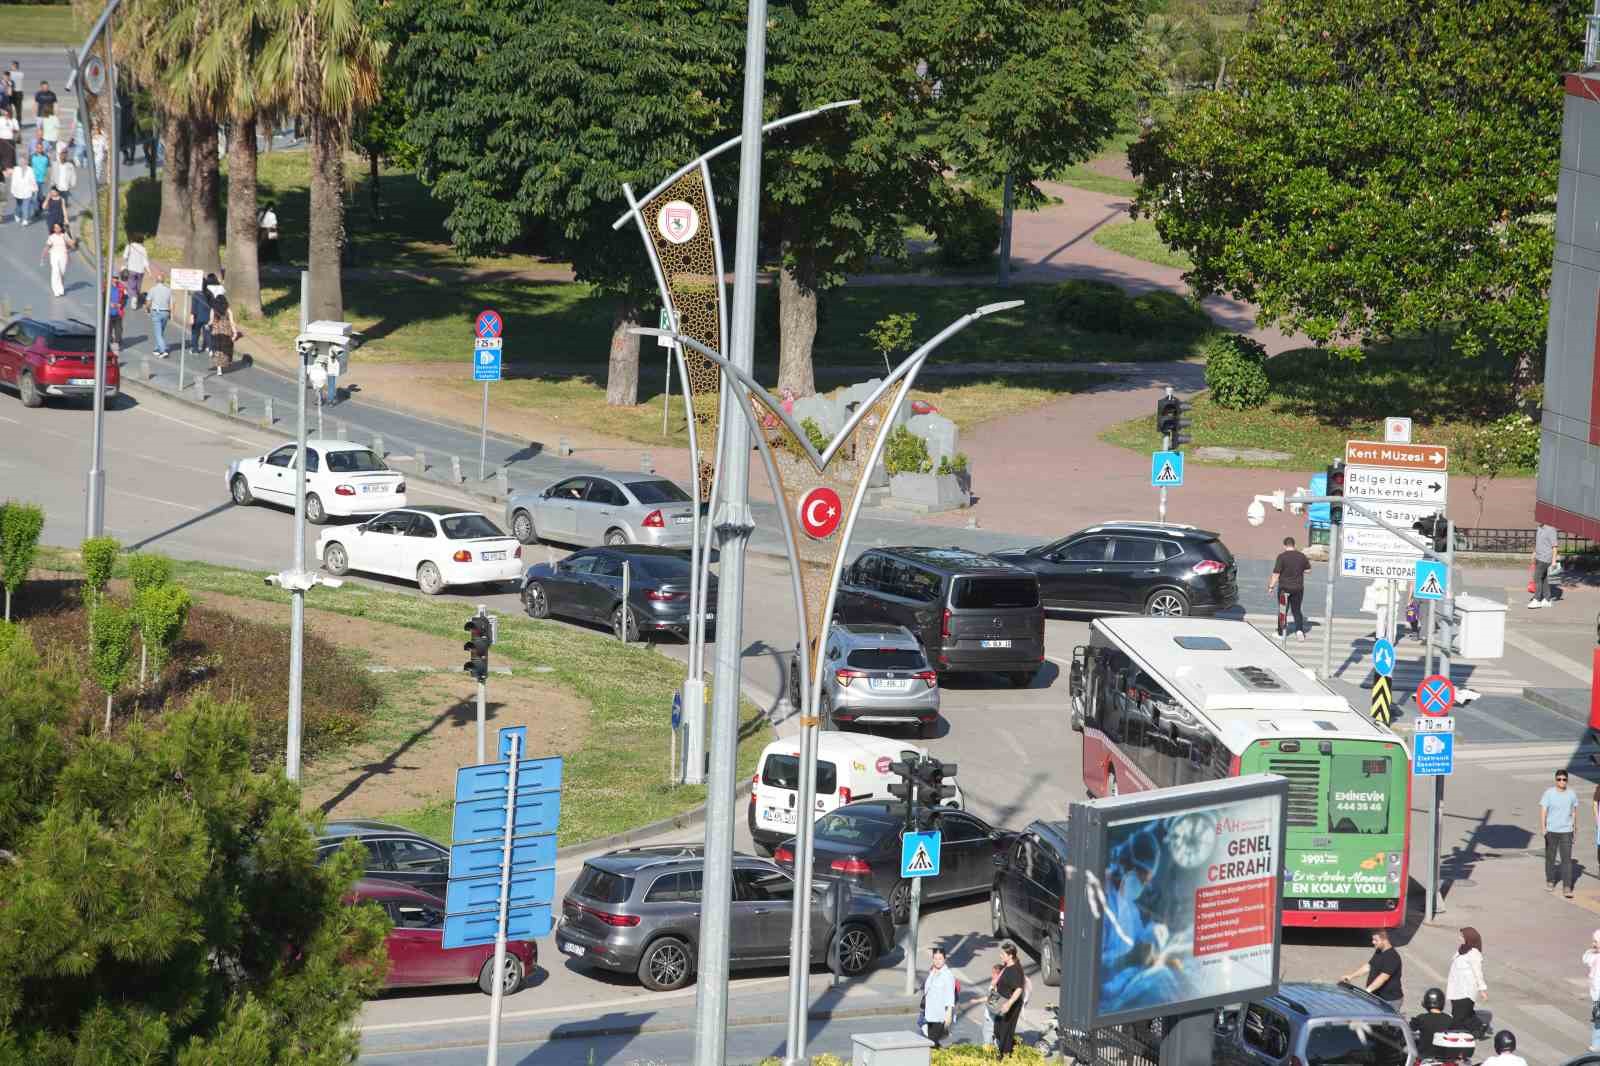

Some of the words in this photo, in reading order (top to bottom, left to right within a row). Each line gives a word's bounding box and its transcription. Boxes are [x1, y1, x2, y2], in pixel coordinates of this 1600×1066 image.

[1349, 447, 1377, 459] Kent
[1349, 486, 1424, 498] Mahkemesi
[1360, 565, 1384, 576] TEKEL
[1337, 802, 1355, 811] 444
[1228, 835, 1271, 857] GENEL
[1208, 852, 1271, 880] CERRAHİ
[1292, 883, 1308, 894] EN
[1311, 883, 1351, 894] KOLAY
[1354, 883, 1387, 894] YOLU
